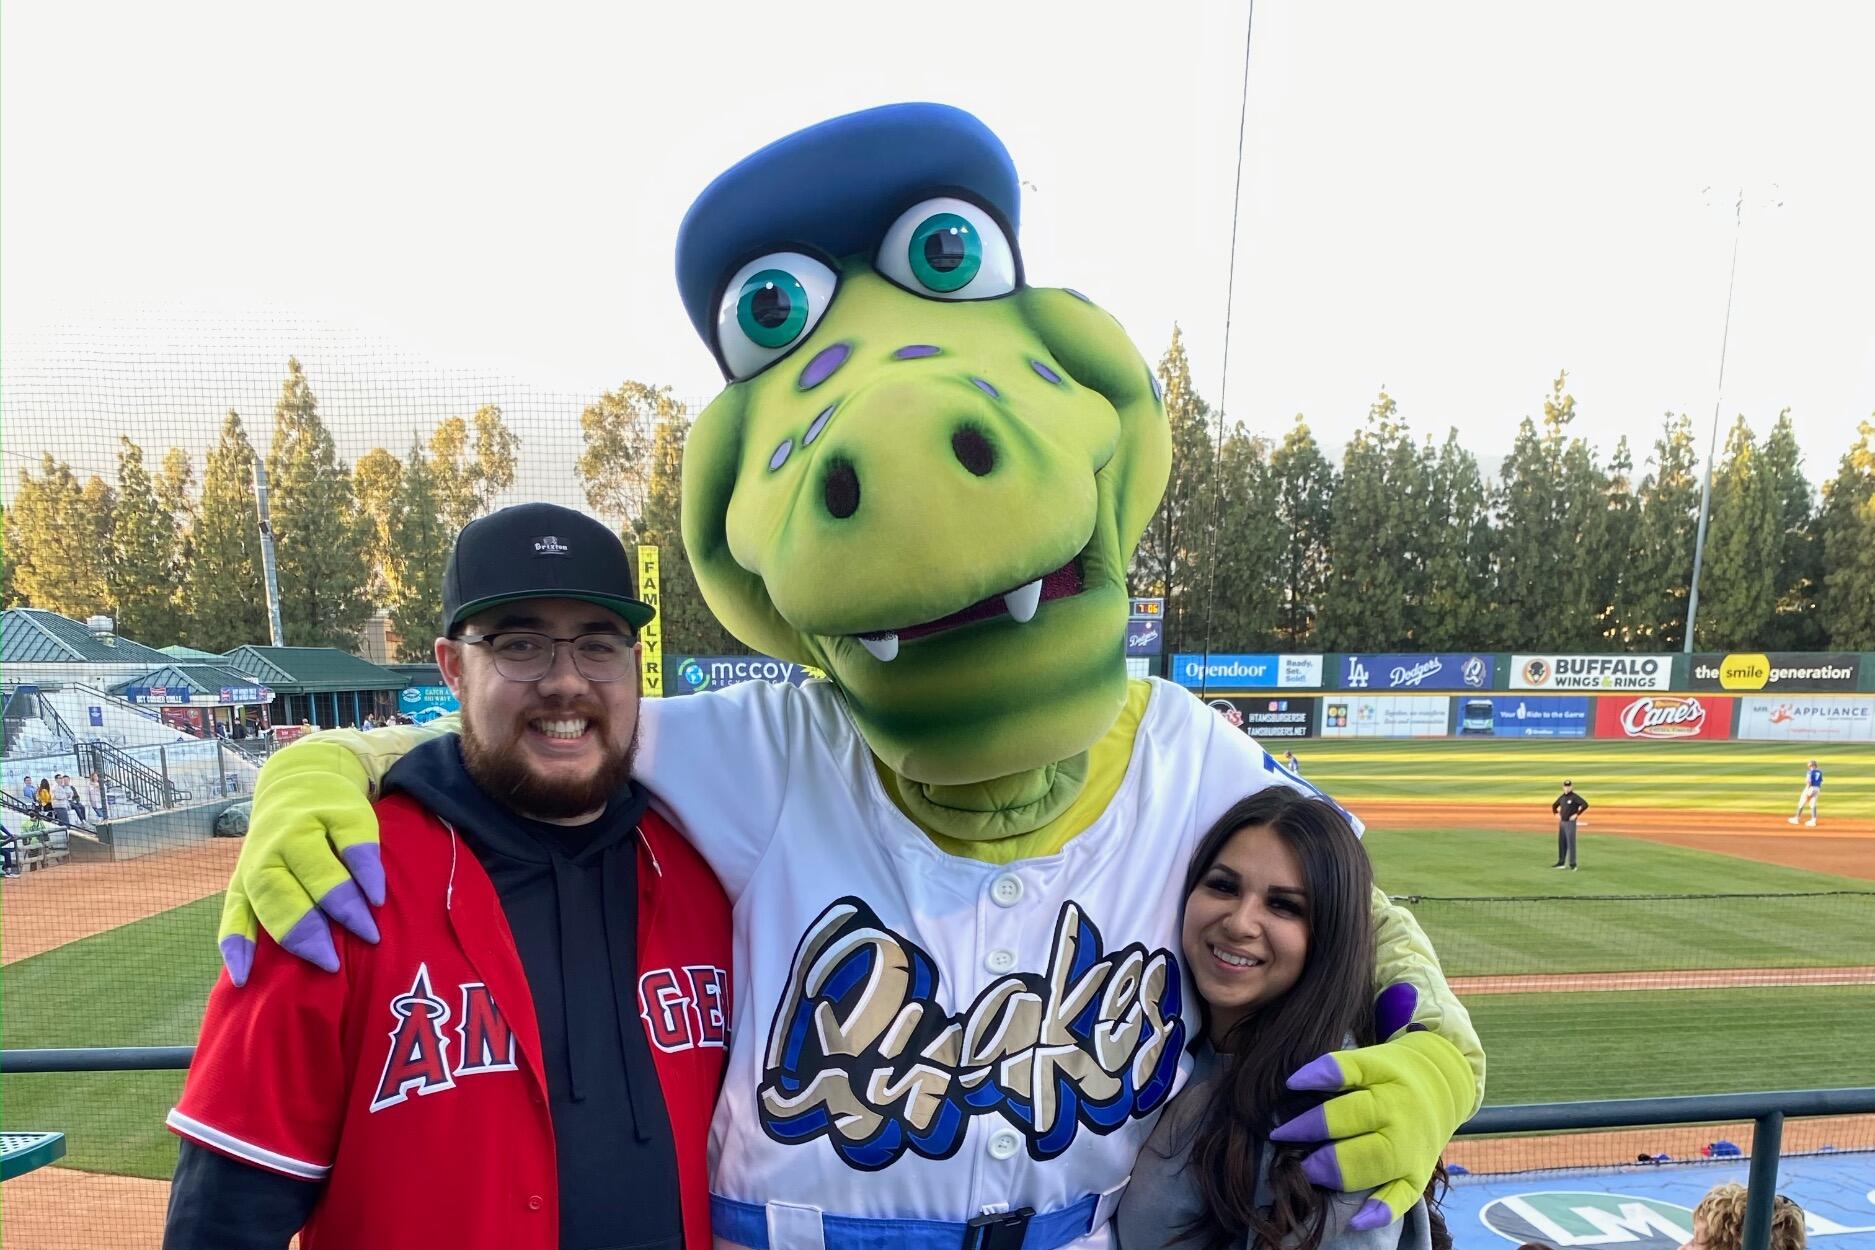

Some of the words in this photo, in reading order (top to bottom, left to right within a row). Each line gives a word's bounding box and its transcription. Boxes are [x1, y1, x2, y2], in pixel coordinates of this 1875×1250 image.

[534, 542, 568, 550] Brixton
[643, 561, 657, 653] FAMLY
[646, 662, 659, 689] RV
[711, 662, 794, 683] mccoy
[1185, 661, 1267, 680] Opendoor
[1347, 656, 1369, 687] LA
[1389, 656, 1442, 687] Dodgers
[1555, 658, 1658, 676] BUFFALO
[1695, 664, 1719, 679] the
[1726, 665, 1763, 679] smile
[1555, 677, 1600, 687] WINGS
[1614, 677, 1656, 687] RINGS
[1624, 697, 1704, 735] Cane's
[1793, 707, 1869, 716] APPLIANCE
[757, 895, 1185, 1171] Quakes
